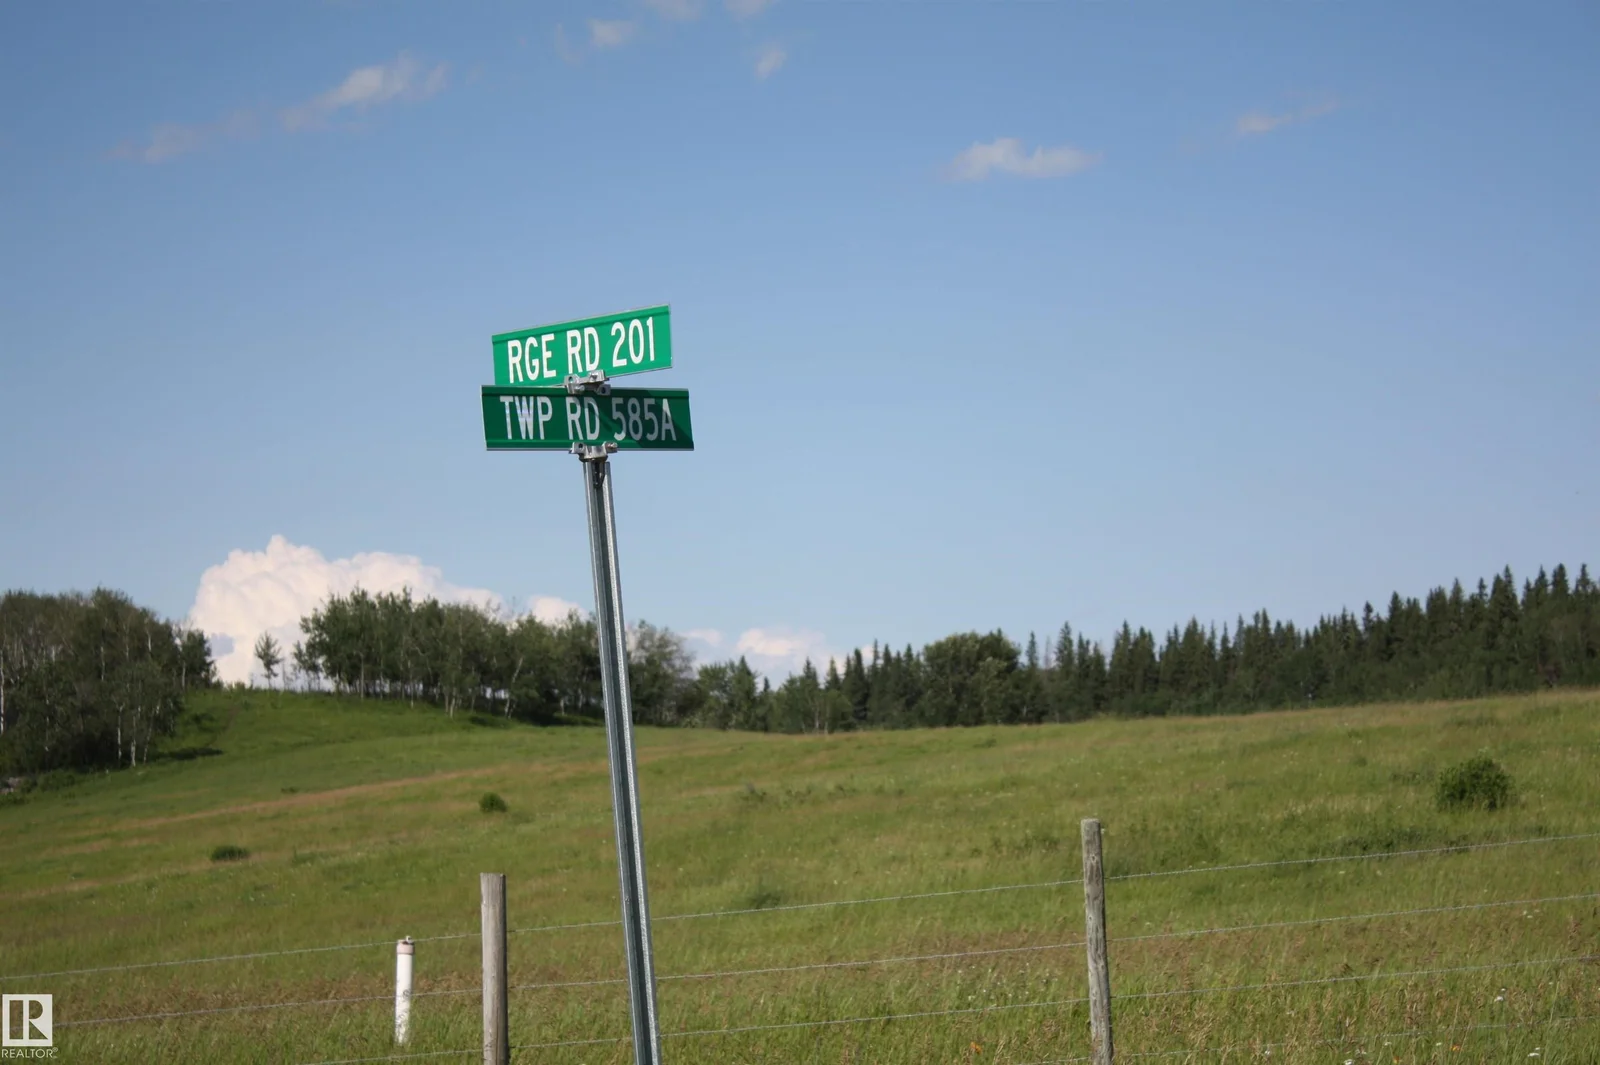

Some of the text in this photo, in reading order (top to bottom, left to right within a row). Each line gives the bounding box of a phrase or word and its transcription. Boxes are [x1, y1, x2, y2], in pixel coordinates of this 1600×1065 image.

[507, 316, 656, 384] RGE RD 201
[500, 395, 677, 441] TWP RD 585A
